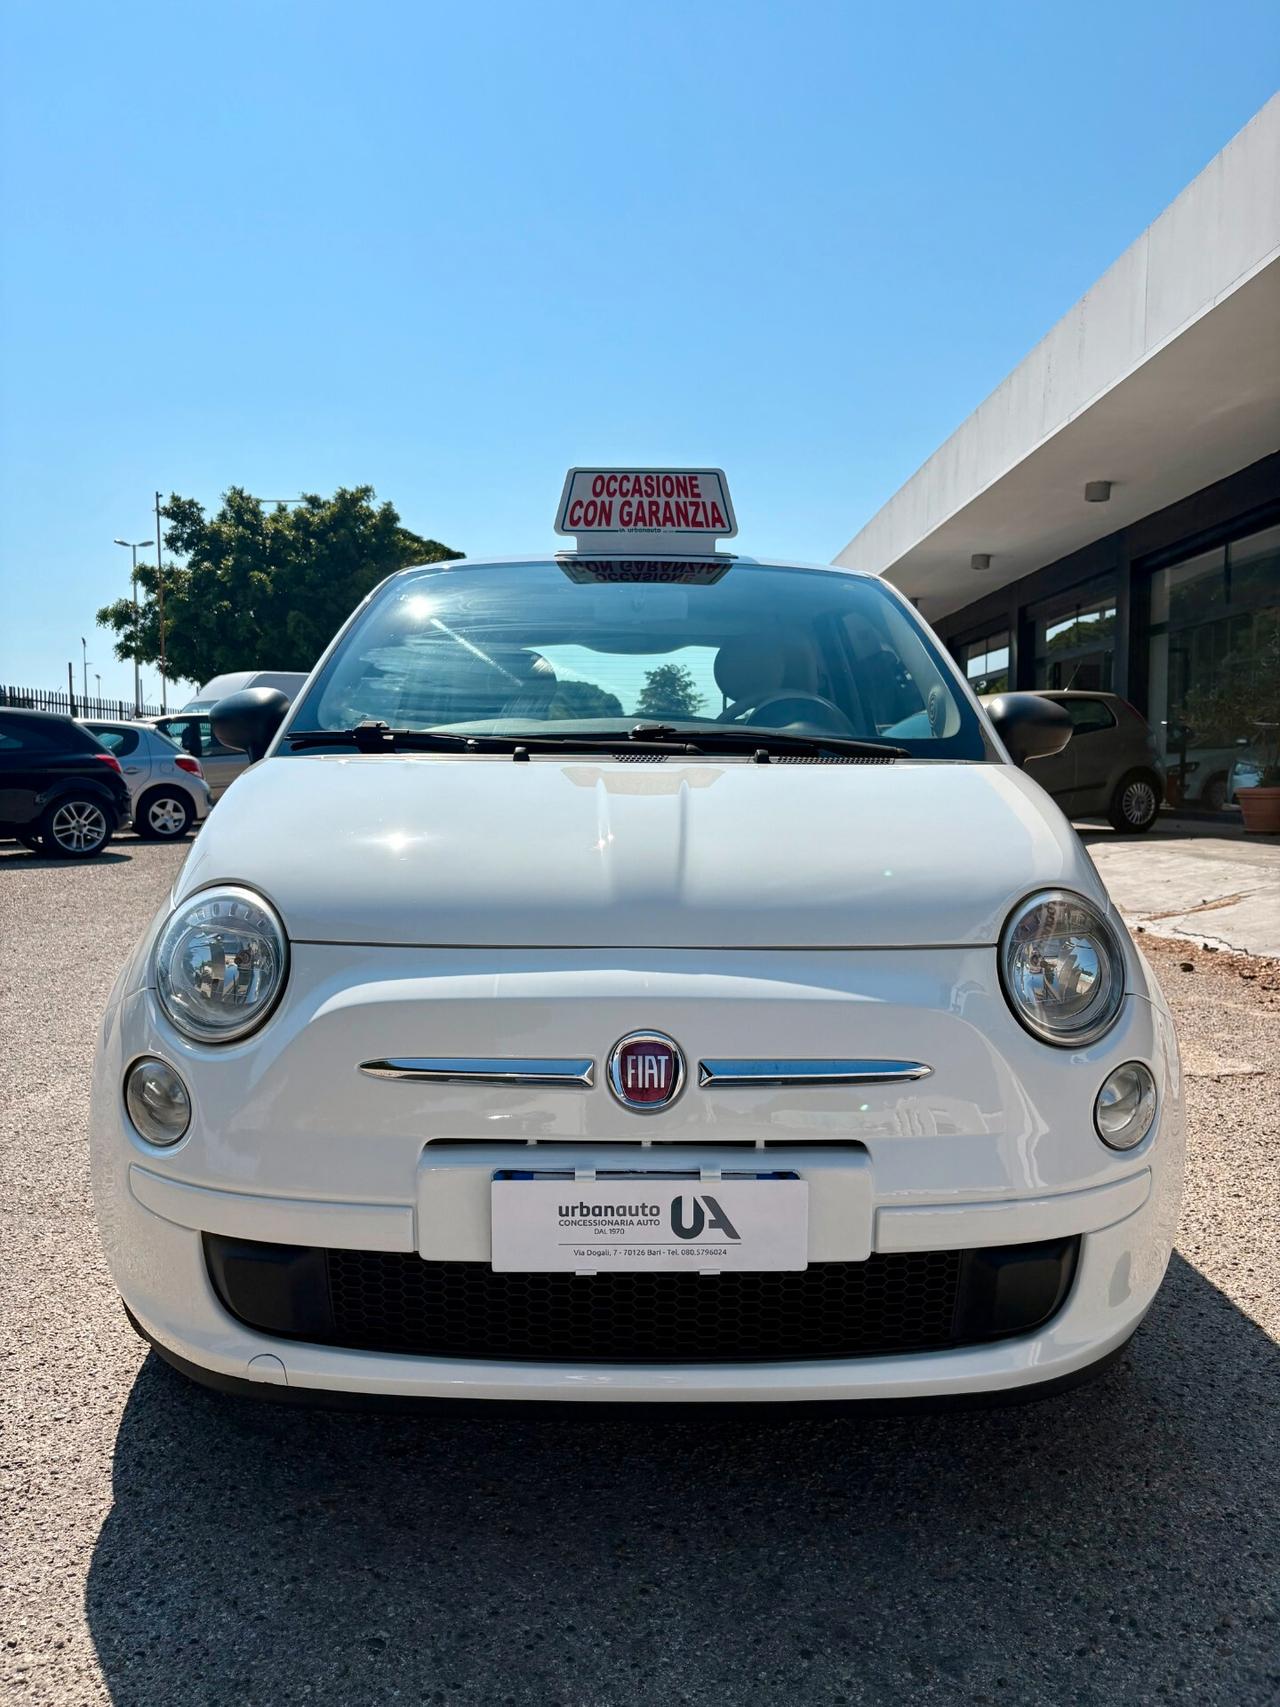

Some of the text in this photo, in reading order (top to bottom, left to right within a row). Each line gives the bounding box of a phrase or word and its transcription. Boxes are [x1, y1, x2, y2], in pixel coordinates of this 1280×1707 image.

[592, 475, 702, 499] OCCASIONE
[569, 500, 726, 528] CON GARANZIA
[626, 1055, 669, 1089] FIAT
[558, 1201, 661, 1217] urbanauto
[670, 1195, 741, 1239] UA
[558, 1219, 635, 1227] CONCESSIONARIA
[586, 1249, 612, 1257] Dogali,
